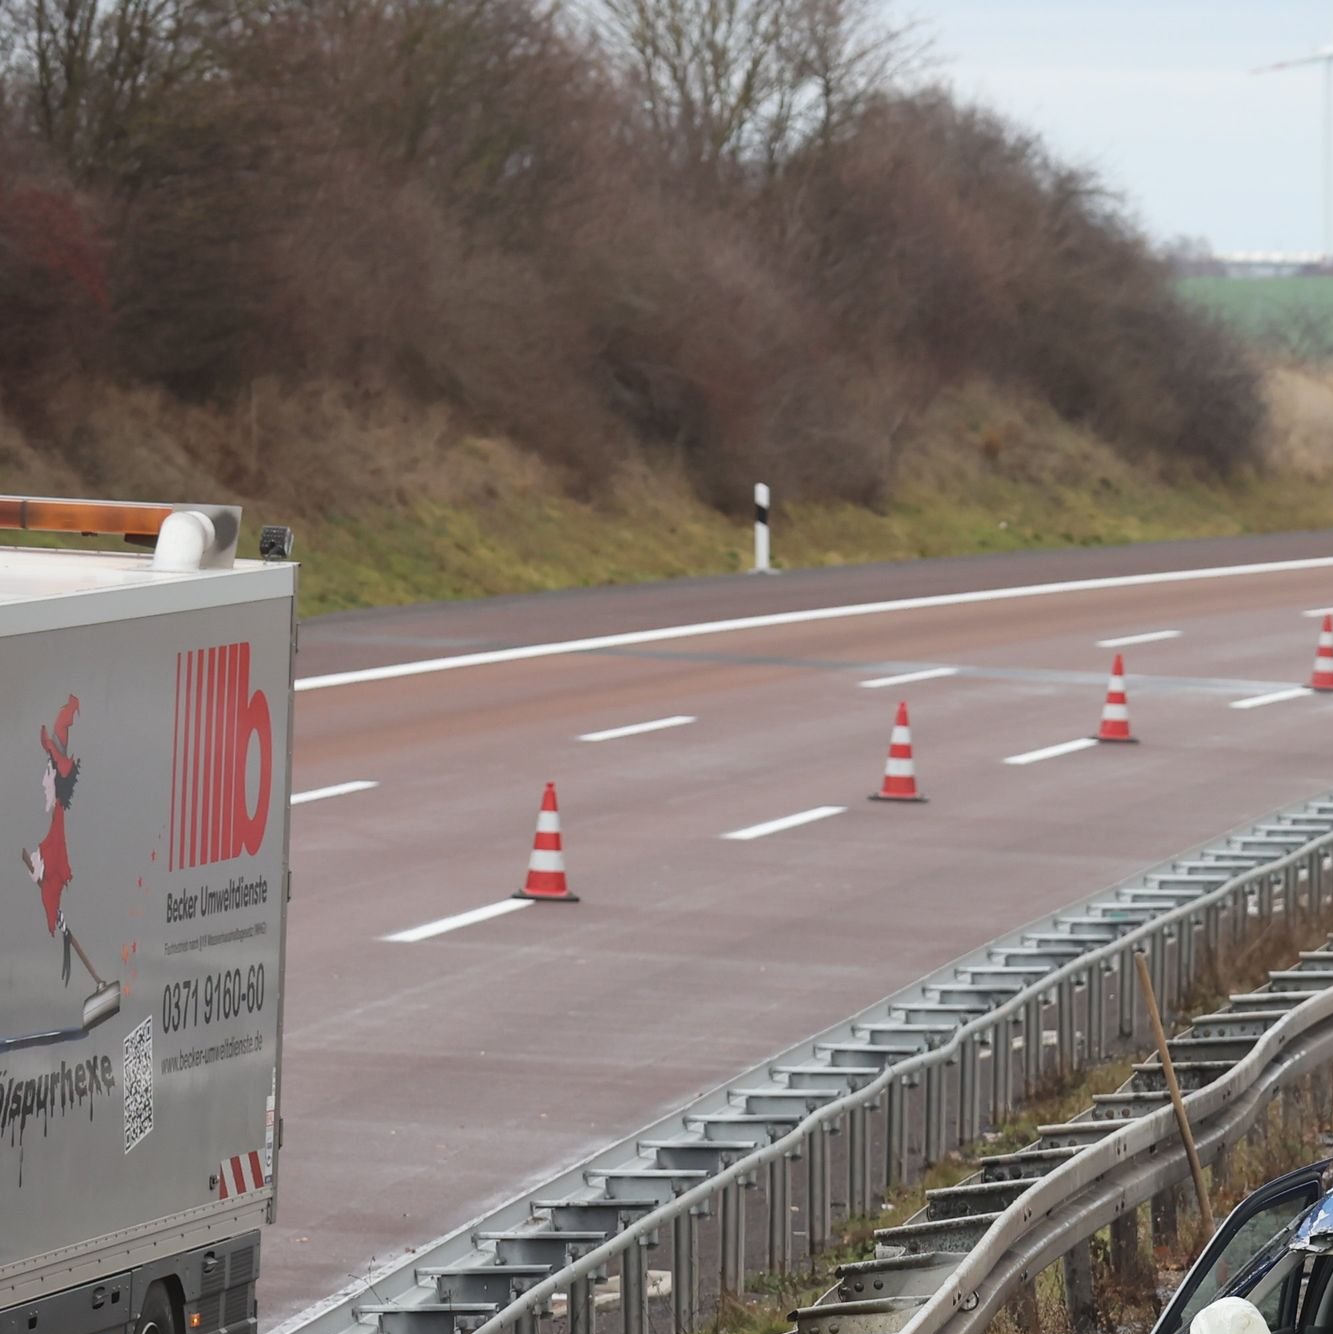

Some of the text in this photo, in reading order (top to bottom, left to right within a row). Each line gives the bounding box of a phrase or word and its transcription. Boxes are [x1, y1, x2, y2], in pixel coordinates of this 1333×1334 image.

[167, 875, 268, 923] Becker Umweltdienste
[162, 963, 264, 1034] 0371 9160-60
[161, 1030, 263, 1075] www.becker-umweltdienste.de
